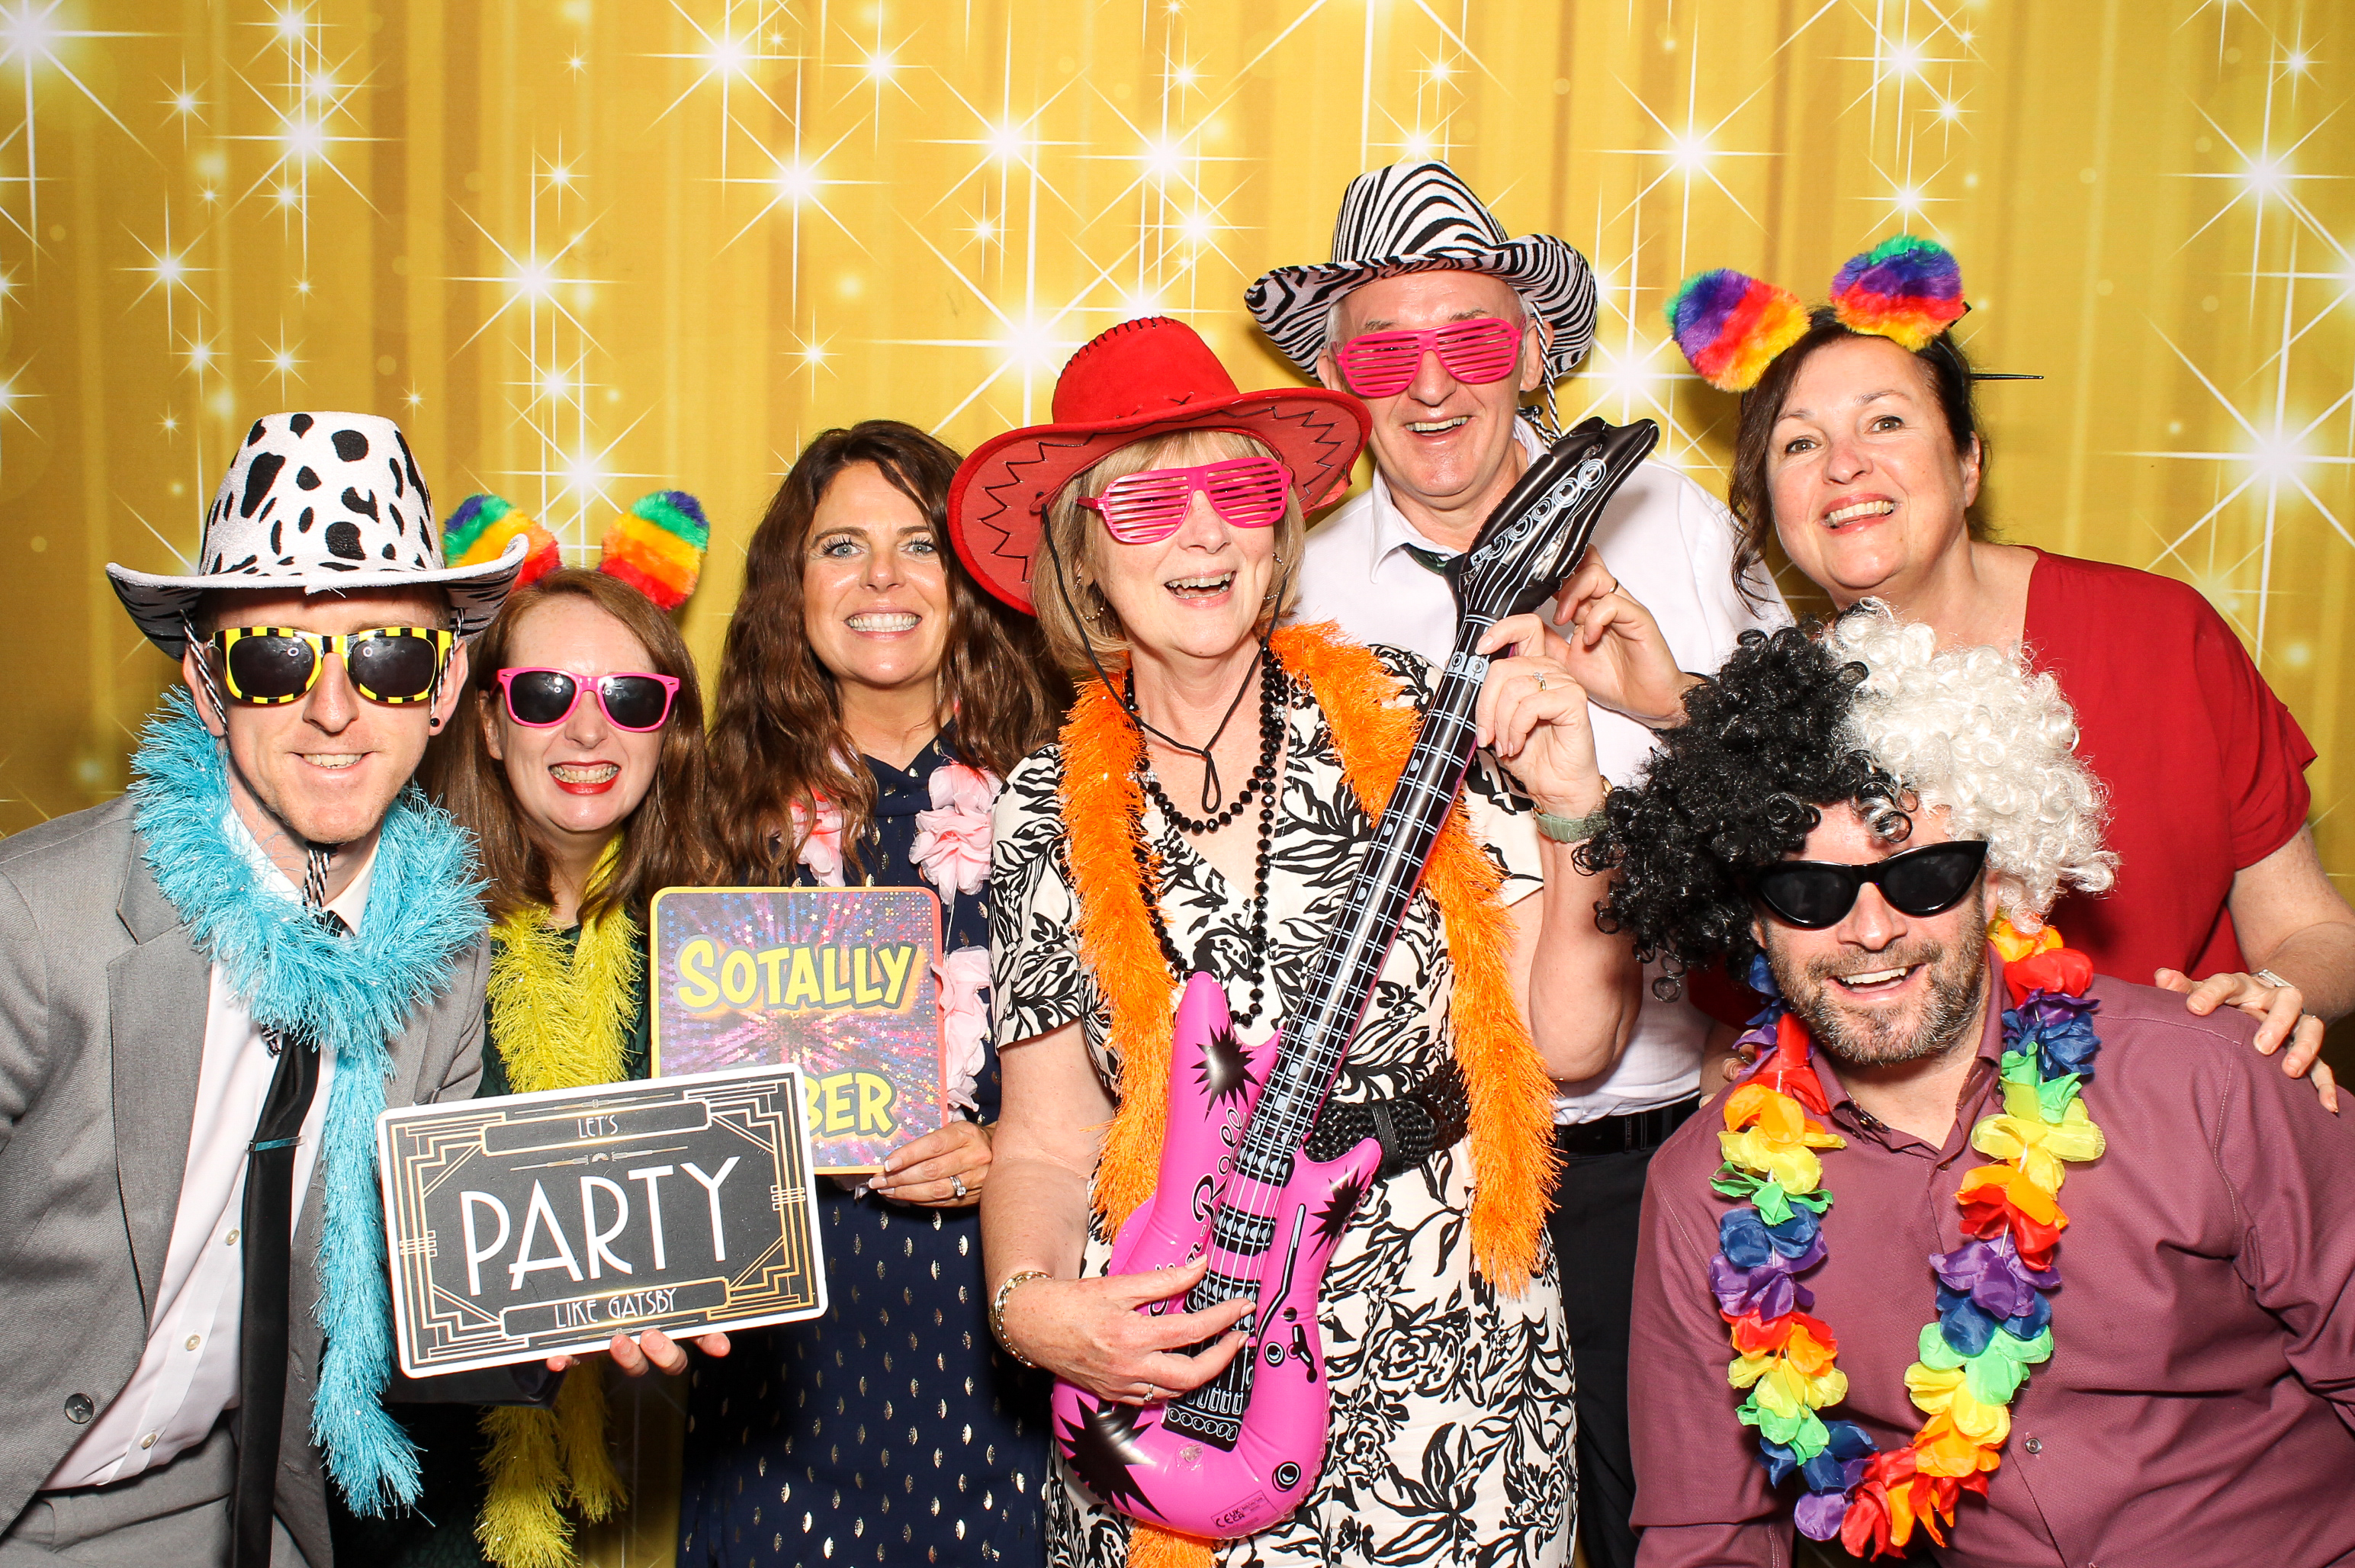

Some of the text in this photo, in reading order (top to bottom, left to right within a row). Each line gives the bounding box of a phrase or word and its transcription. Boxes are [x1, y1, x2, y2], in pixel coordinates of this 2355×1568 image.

[676, 938, 914, 1008] SOTALLY
[577, 1114, 619, 1139] LET'S
[804, 1071, 894, 1133] BER
[459, 1156, 741, 1296] PARTY
[554, 1287, 678, 1329] LIKE GATSBY
